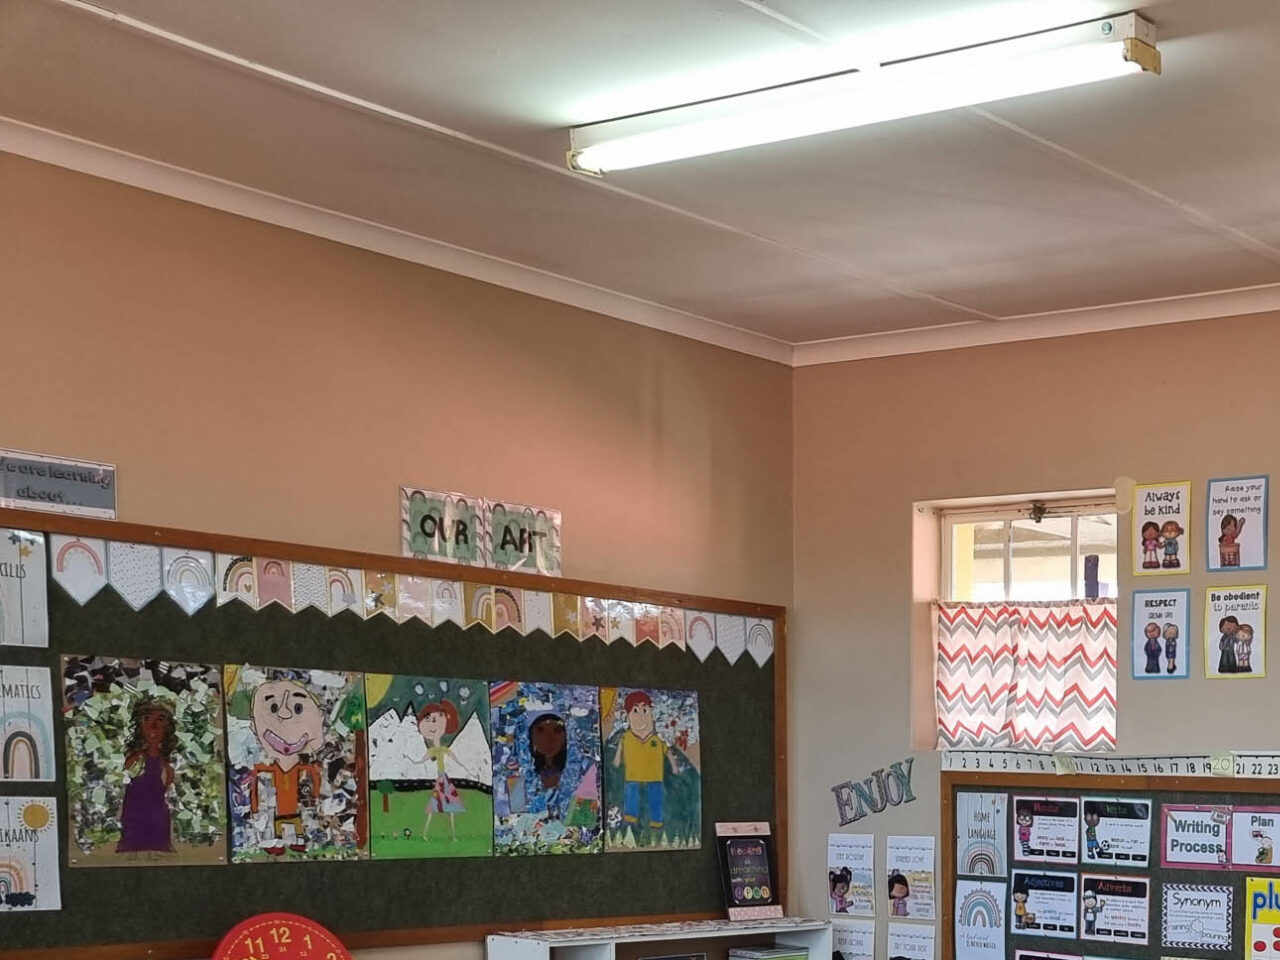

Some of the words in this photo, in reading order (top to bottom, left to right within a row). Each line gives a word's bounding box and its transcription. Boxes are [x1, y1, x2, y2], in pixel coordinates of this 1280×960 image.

[49, 464, 111, 490] learning
[1144, 490, 1180, 503] Always
[1144, 504, 1156, 516] be
[1158, 503, 1180, 515] kind
[420, 514, 469, 546] OUR
[500, 525, 547, 554] ART
[1144, 598, 1177, 608] RESPECT
[1211, 593, 1221, 602] Be
[1224, 592, 1260, 601] obedient
[1252, 766, 1263, 775] 22
[831, 757, 917, 827] ENJOY
[973, 811, 990, 823] HOME
[1250, 816, 1274, 828] Plan
[968, 828, 996, 840] LANGUAGE
[1174, 819, 1220, 837] Writing
[1171, 840, 1223, 854] Process
[1098, 882, 1132, 893] Adverbs
[1172, 892, 1221, 911] Synonym
[270, 927, 292, 943] 12
[244, 937, 265, 954] 11
[303, 934, 313, 950] 1
